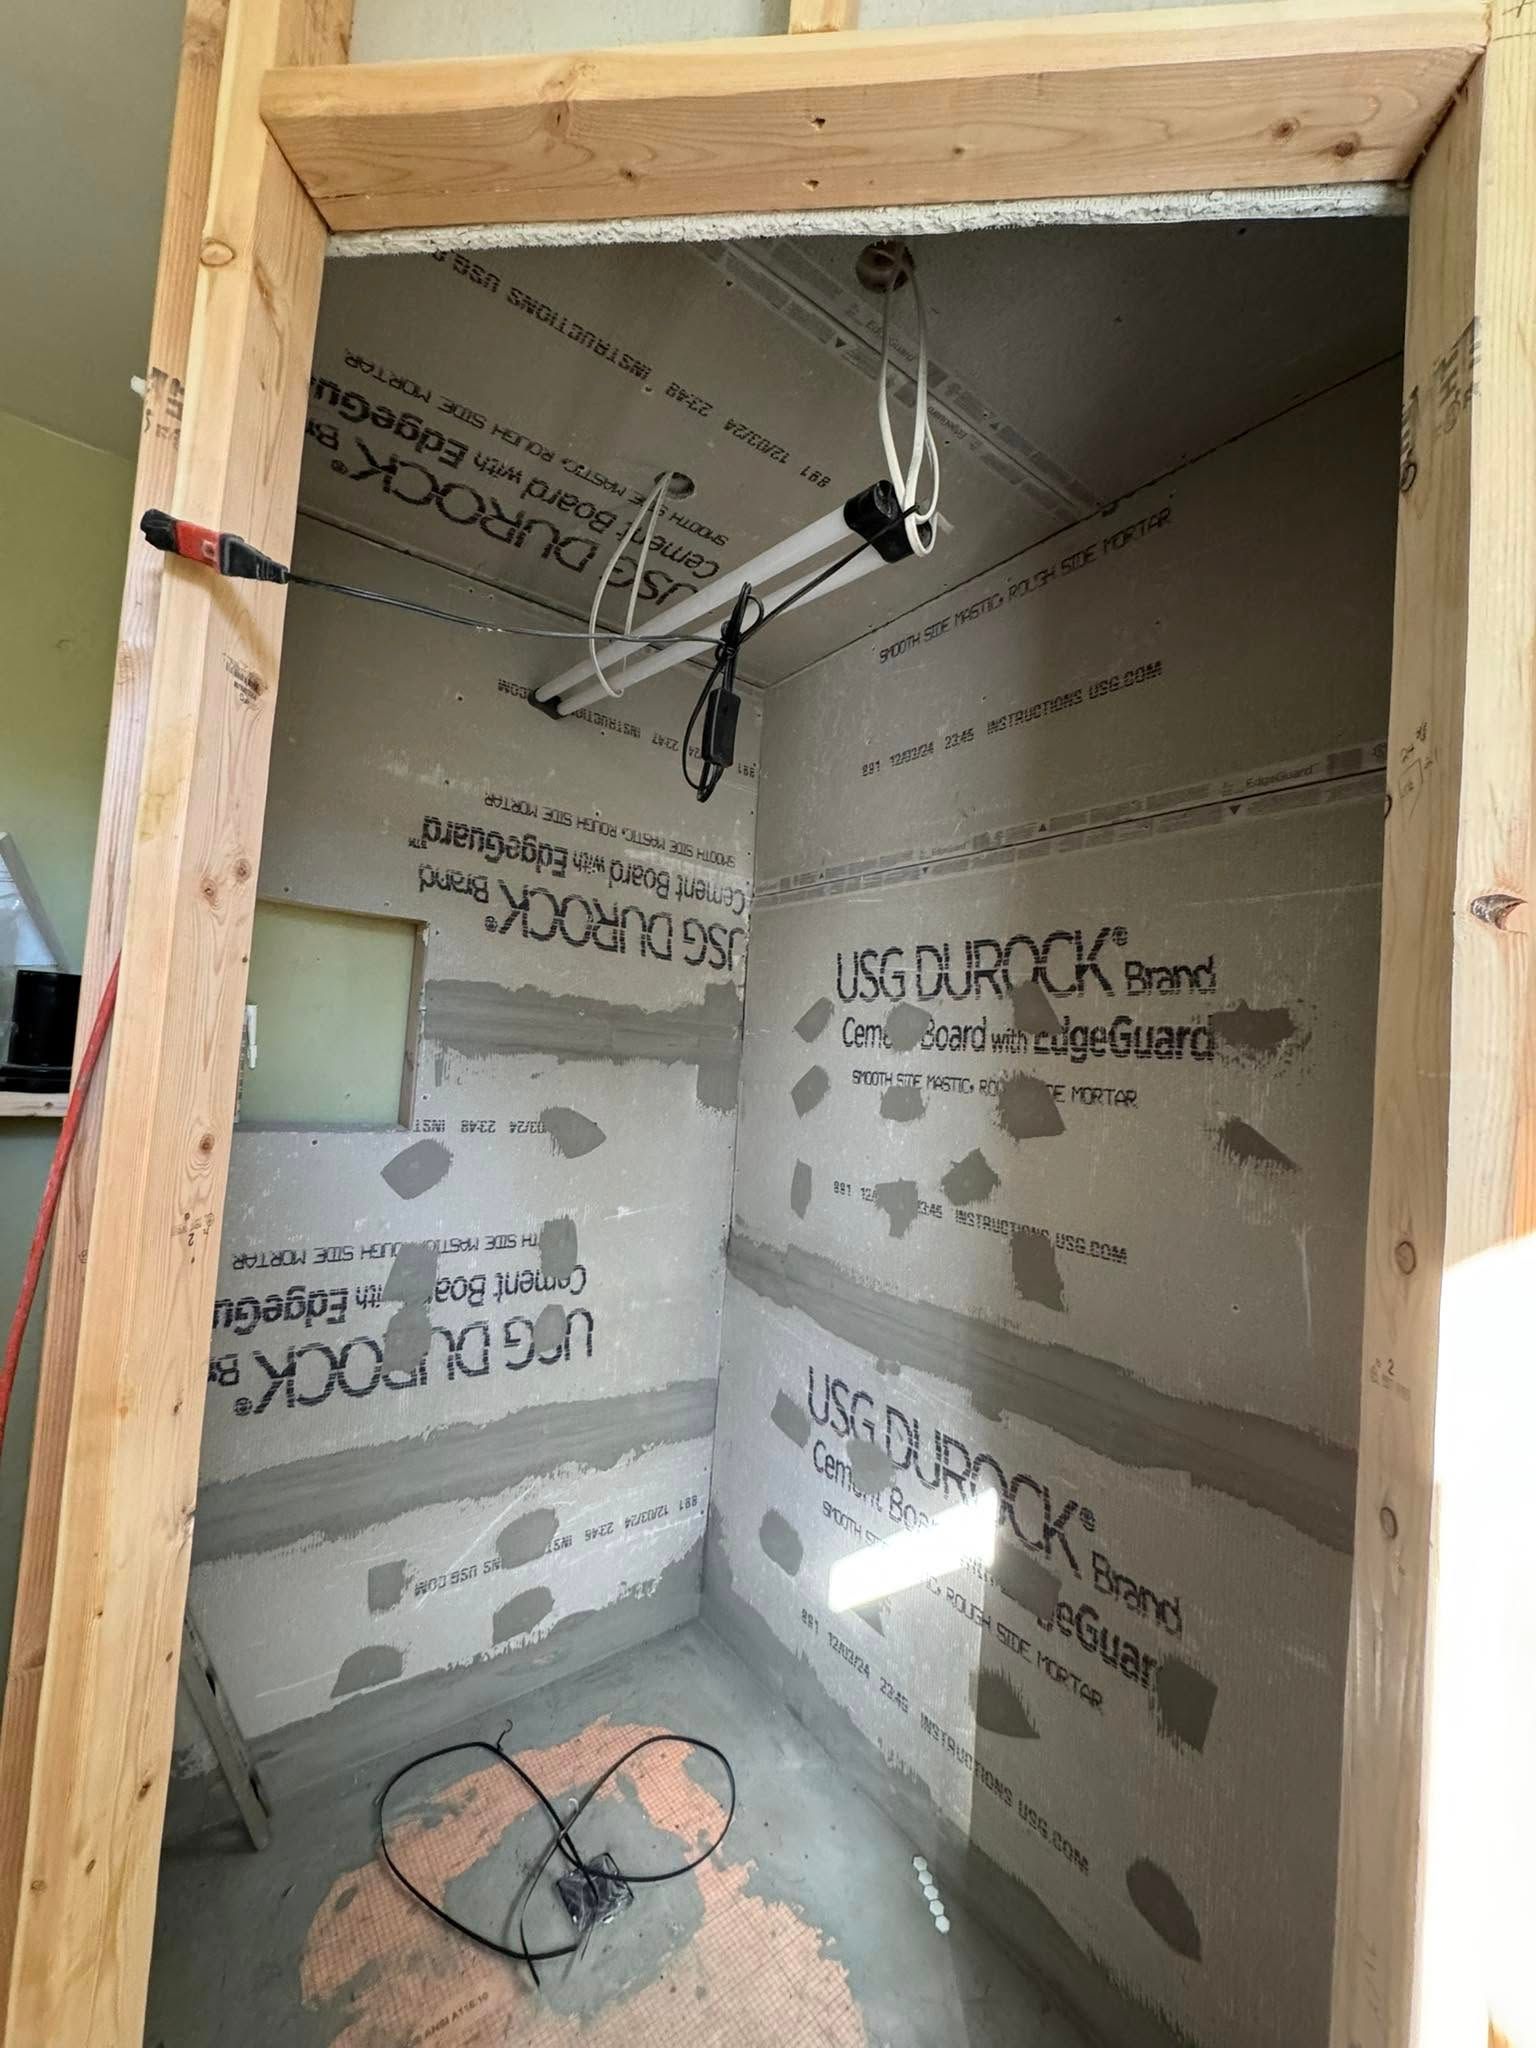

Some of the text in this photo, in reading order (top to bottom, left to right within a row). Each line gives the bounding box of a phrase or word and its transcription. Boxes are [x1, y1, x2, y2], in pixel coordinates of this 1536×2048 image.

[507, 287, 652, 381] INSTRUCTIONS
[307, 374, 469, 470] EdgeGu
[437, 395, 488, 431] SIDE
[491, 423, 555, 464] ROUGH
[472, 449, 524, 486] with
[520, 477, 618, 535] Board
[669, 512, 729, 547] SMOOTH
[879, 632, 922, 664] SMOOTH
[923, 615, 952, 644] SIDE
[1007, 566, 1057, 602] ROUGH
[1060, 542, 1098, 577] SIDE
[1103, 506, 1172, 556] MORTAR
[986, 688, 1083, 735] INSTRUCTIONS
[542, 806, 573, 827] SIDE
[576, 816, 618, 837] ROUGH
[572, 851, 605, 873] with
[668, 838, 695, 858] SIDE
[696, 847, 736, 868] SMOOTH
[417, 863, 490, 904] Brand
[608, 859, 671, 900] Board
[675, 874, 747, 916] Cement
[837, 946, 906, 1002] USG
[1124, 953, 1216, 996] Brand
[991, 1028, 1028, 1054] with
[852, 1069, 892, 1087] SMOOTH
[1071, 1086, 1138, 1109] MORTAR
[232, 1249, 306, 1270] MORTAR
[313, 1246, 354, 1264] SIDE
[485, 1234, 517, 1250] SIDE
[354, 1284, 383, 1310] ith
[808, 1365, 876, 1443] USG
[1091, 1550, 1184, 1640] Brand
[822, 1500, 863, 1538] SMOOTH
[946, 1586, 992, 1632] ROUGH
[996, 1621, 1033, 1664] SIDE
[1037, 1650, 1104, 1709] MORTAR
[920, 1712, 1013, 1808] INSTRUCTIONS
